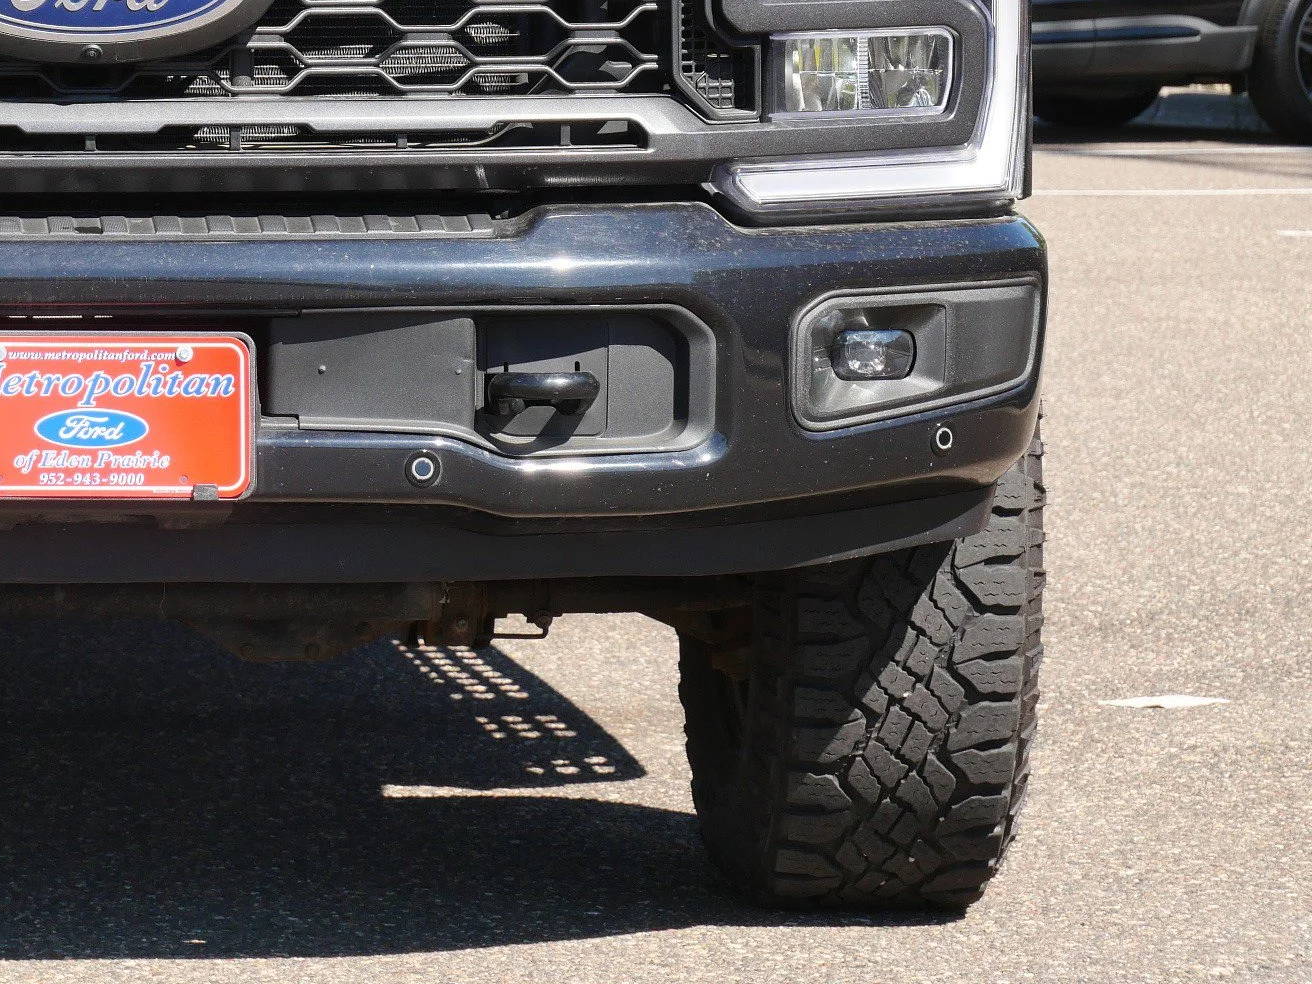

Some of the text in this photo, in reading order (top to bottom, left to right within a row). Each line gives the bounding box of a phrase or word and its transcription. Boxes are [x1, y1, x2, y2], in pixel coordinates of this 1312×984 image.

[8, 350, 176, 362] www.metropolitanford.com
[58, 416, 123, 440] Ford
[14, 449, 170, 473] of Eden Prairie
[39, 472, 145, 485] 952-943-9000
